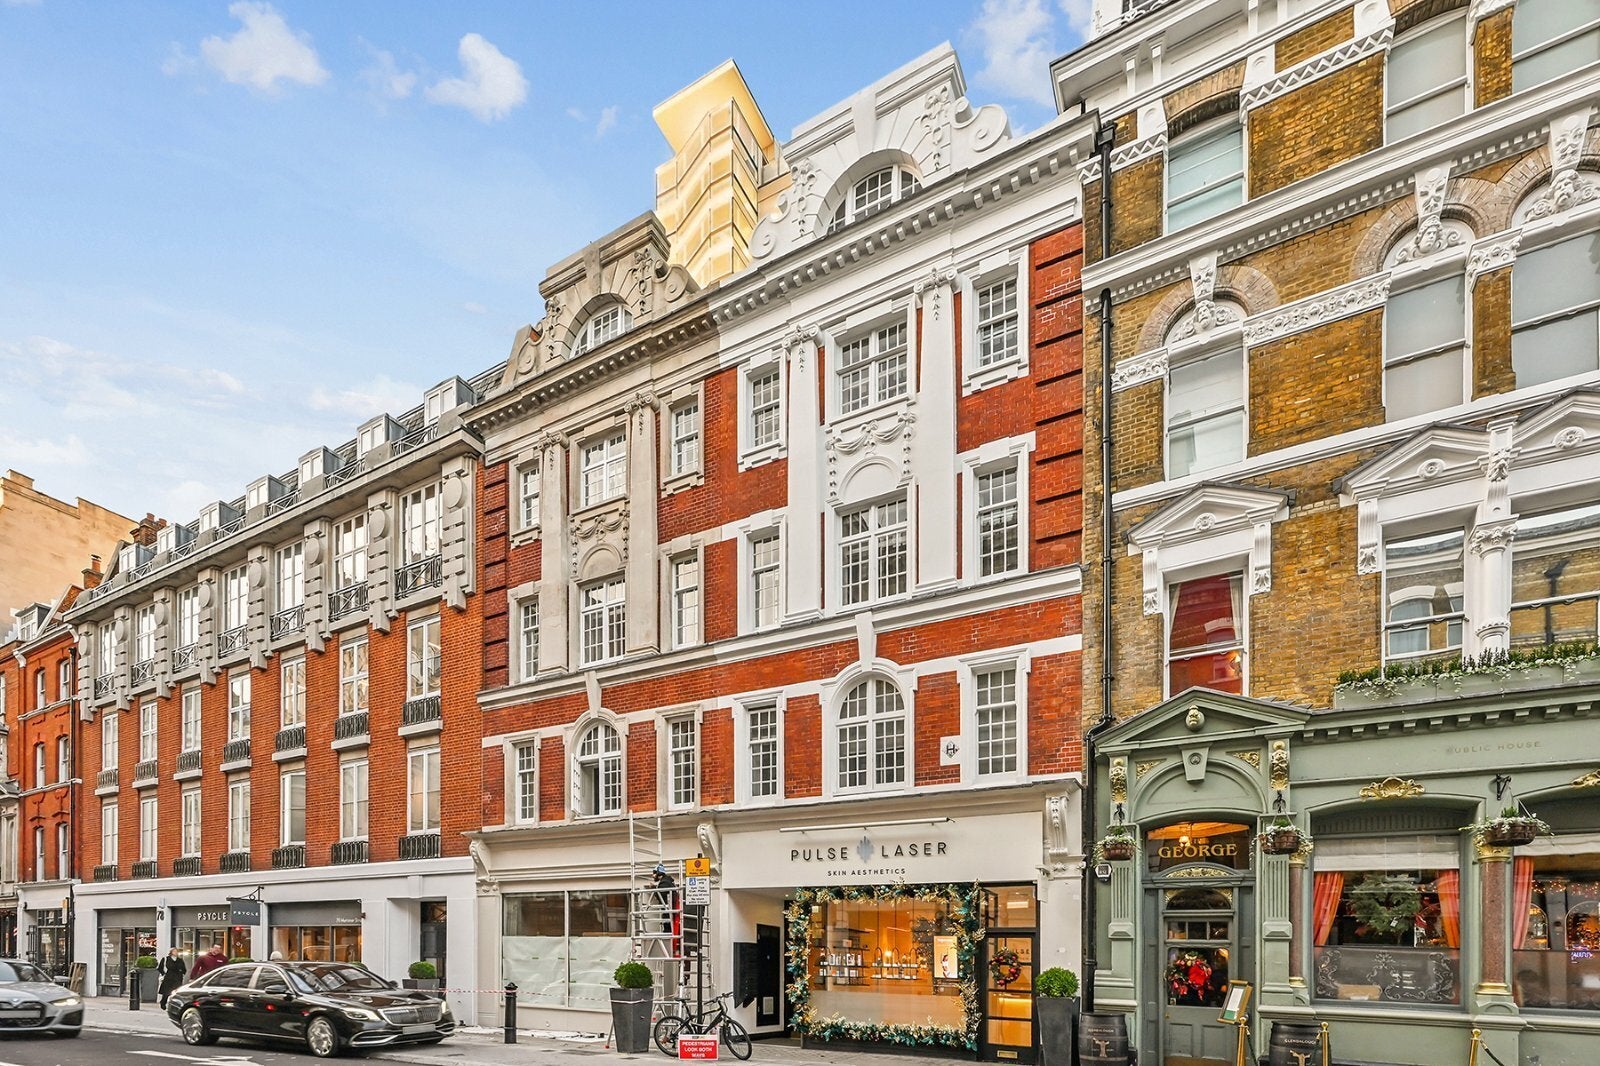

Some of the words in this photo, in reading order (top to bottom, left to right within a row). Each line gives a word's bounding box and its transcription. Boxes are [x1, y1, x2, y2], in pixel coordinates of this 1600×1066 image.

[1447, 745, 1491, 754] PUBLIC
[1498, 741, 1542, 751] HOUSE
[790, 846, 848, 861] PULSE
[881, 842, 947, 858] LASER
[1158, 843, 1238, 858] GEORGE
[851, 868, 906, 876] AESTHETICS
[197, 912, 227, 921] PSYCLE
